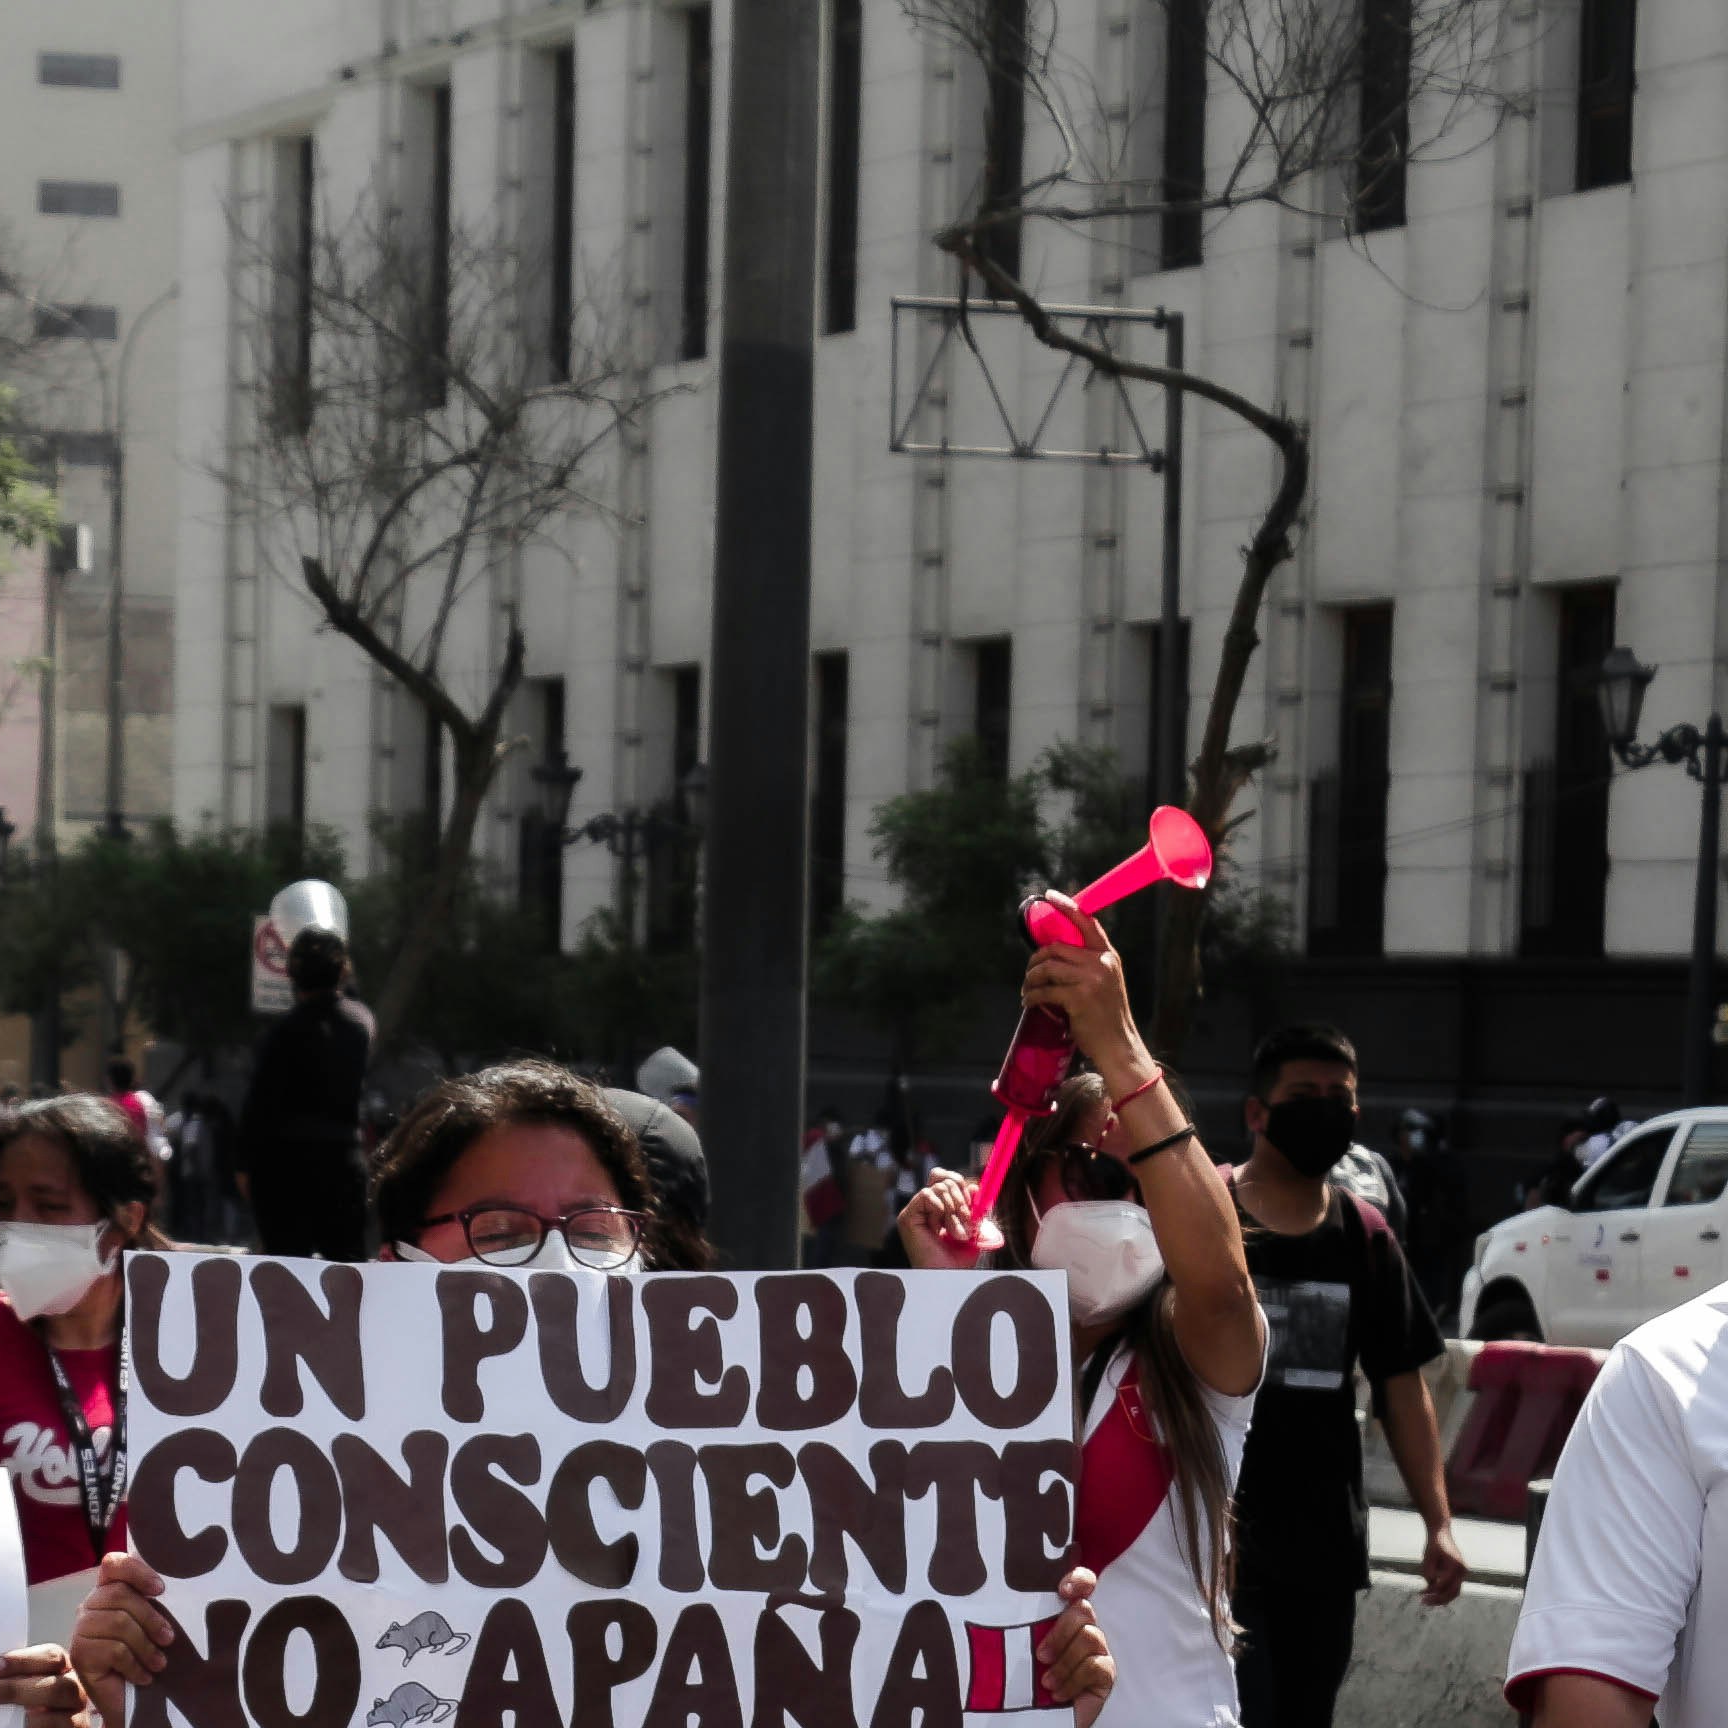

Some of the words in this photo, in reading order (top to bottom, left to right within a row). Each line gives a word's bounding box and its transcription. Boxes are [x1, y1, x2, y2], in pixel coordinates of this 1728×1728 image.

[126, 1255, 365, 1420] UN
[435, 1268, 1057, 1430] PUEBLO
[126, 1427, 1082, 1596] CONSCIENTE
